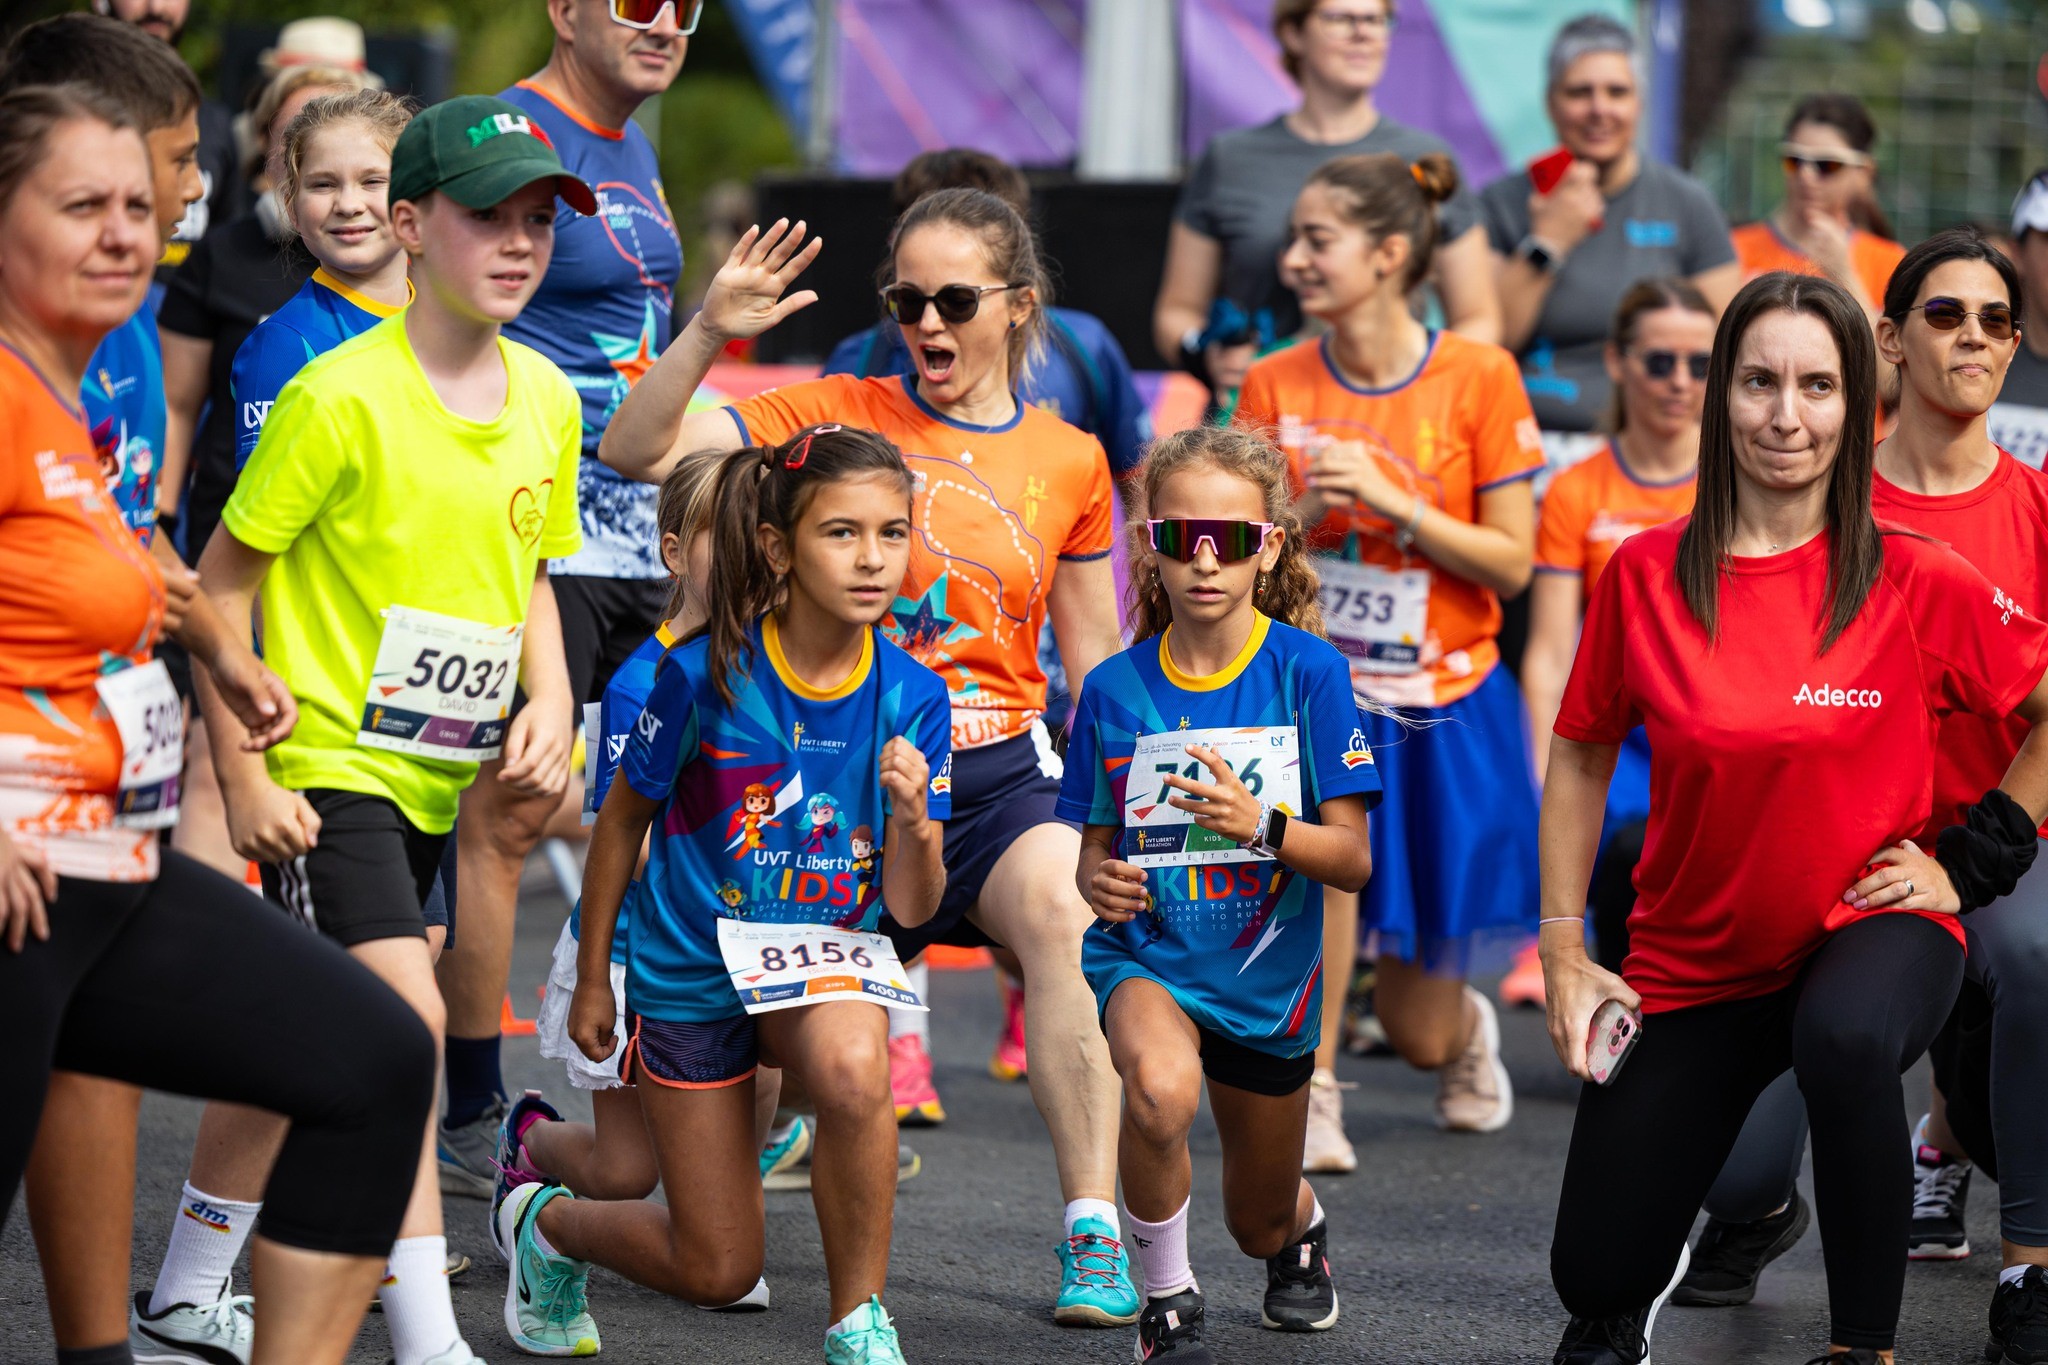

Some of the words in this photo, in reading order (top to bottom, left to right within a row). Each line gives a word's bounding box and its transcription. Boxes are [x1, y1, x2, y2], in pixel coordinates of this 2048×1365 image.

[406, 648, 508, 699] 5032
[439, 697, 479, 713] DAVID
[1792, 683, 1882, 708] Adecco
[800, 746, 839, 755] MARATHON
[816, 740, 847, 749] LIBERTY
[1155, 757, 1263, 804] 716
[754, 850, 791, 867] UVT
[795, 853, 852, 873] Liberty
[752, 867, 853, 907] KIDS
[1157, 863, 1261, 903] KIDS
[823, 907, 849, 916] RUN
[1167, 904, 1199, 913] DARE
[1236, 900, 1261, 909] RUN
[1168, 914, 1200, 923] DARE
[1237, 910, 1261, 919] RUN
[1237, 920, 1261, 929] RUN
[761, 941, 874, 972] 8156
[867, 983, 897, 998] 400
[901, 993, 915, 1003] m
[191, 1201, 228, 1224] dm
